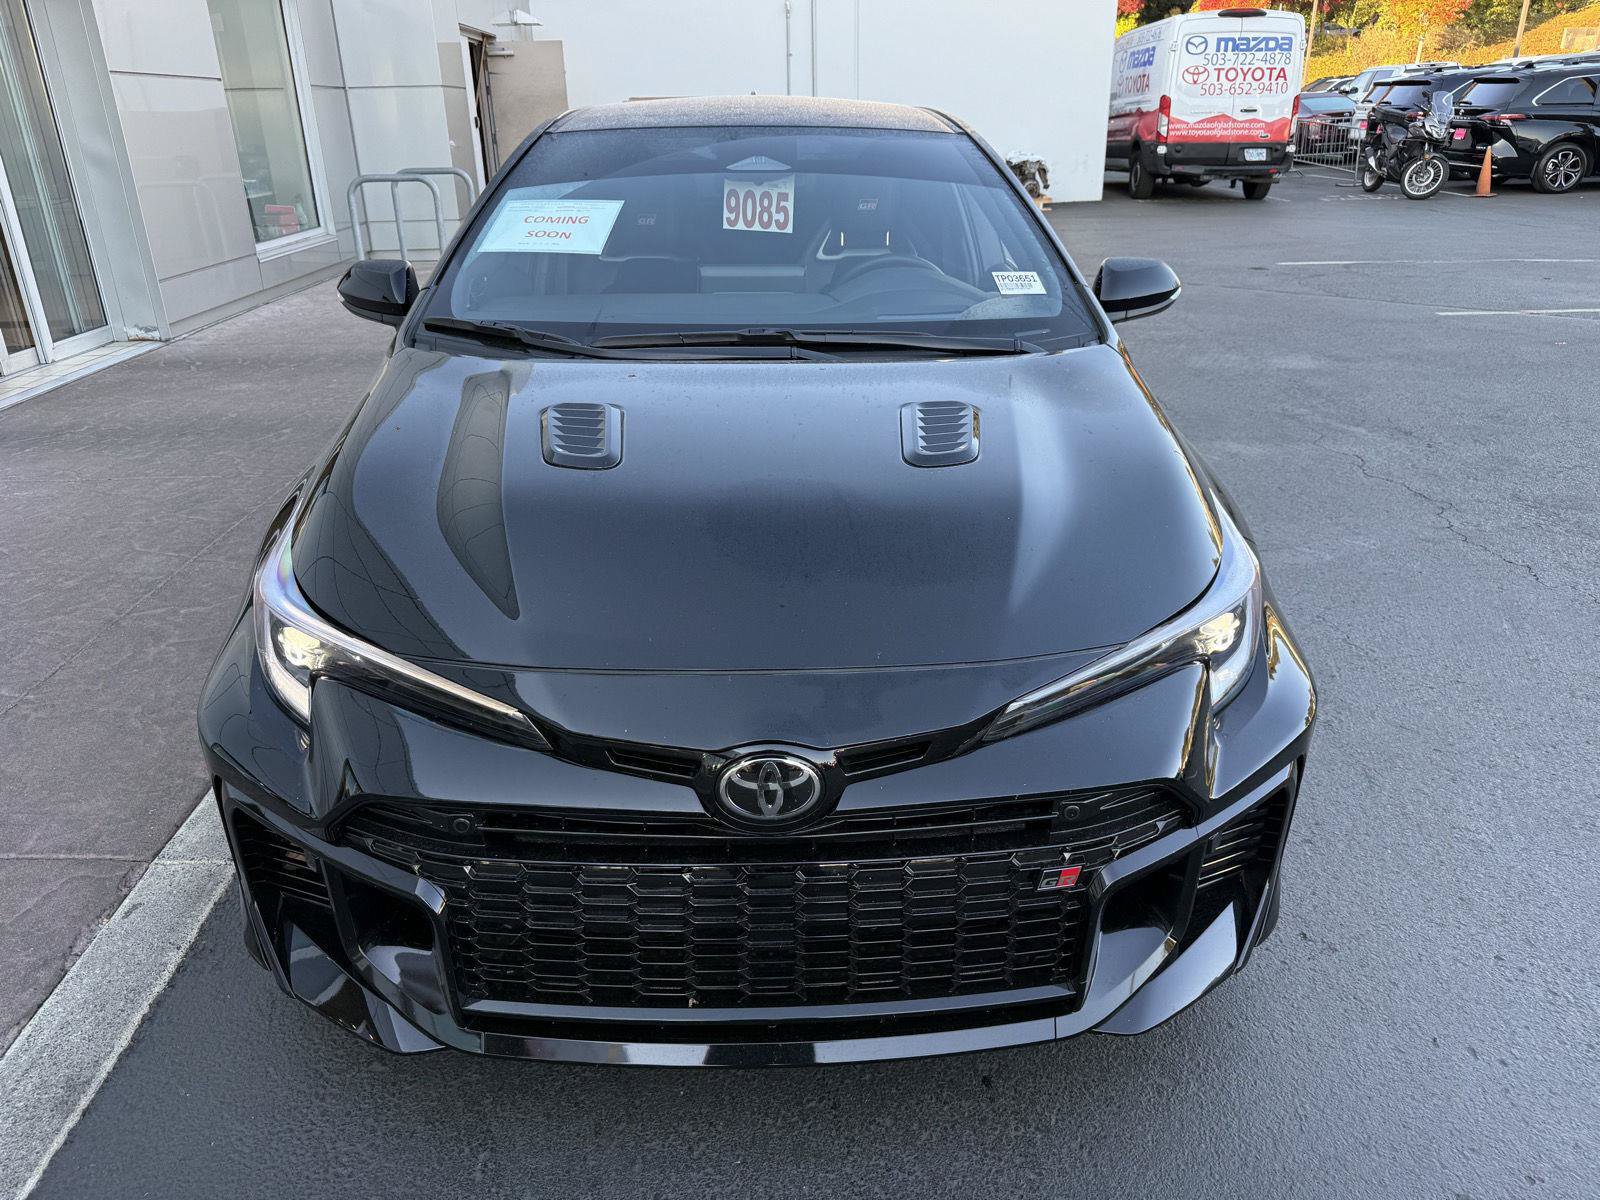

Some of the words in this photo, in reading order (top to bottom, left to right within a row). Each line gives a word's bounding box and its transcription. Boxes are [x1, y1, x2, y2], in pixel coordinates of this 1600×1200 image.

[1203, 52, 1292, 66] 503-722-4878
[1214, 67, 1288, 82] TOYOTA
[1125, 73, 1150, 94] TOYOTA
[1200, 82, 1288, 96] 503-652-9410
[1169, 121, 1265, 132] www.mazdaofgladstone.com
[1169, 128, 1264, 138] www.toyotaofgladstone.com
[725, 188, 790, 231] 9085
[524, 215, 589, 224] COMING
[525, 230, 572, 240] SOON
[994, 274, 1038, 283] TP03651
[1040, 874, 1078, 888] GR
